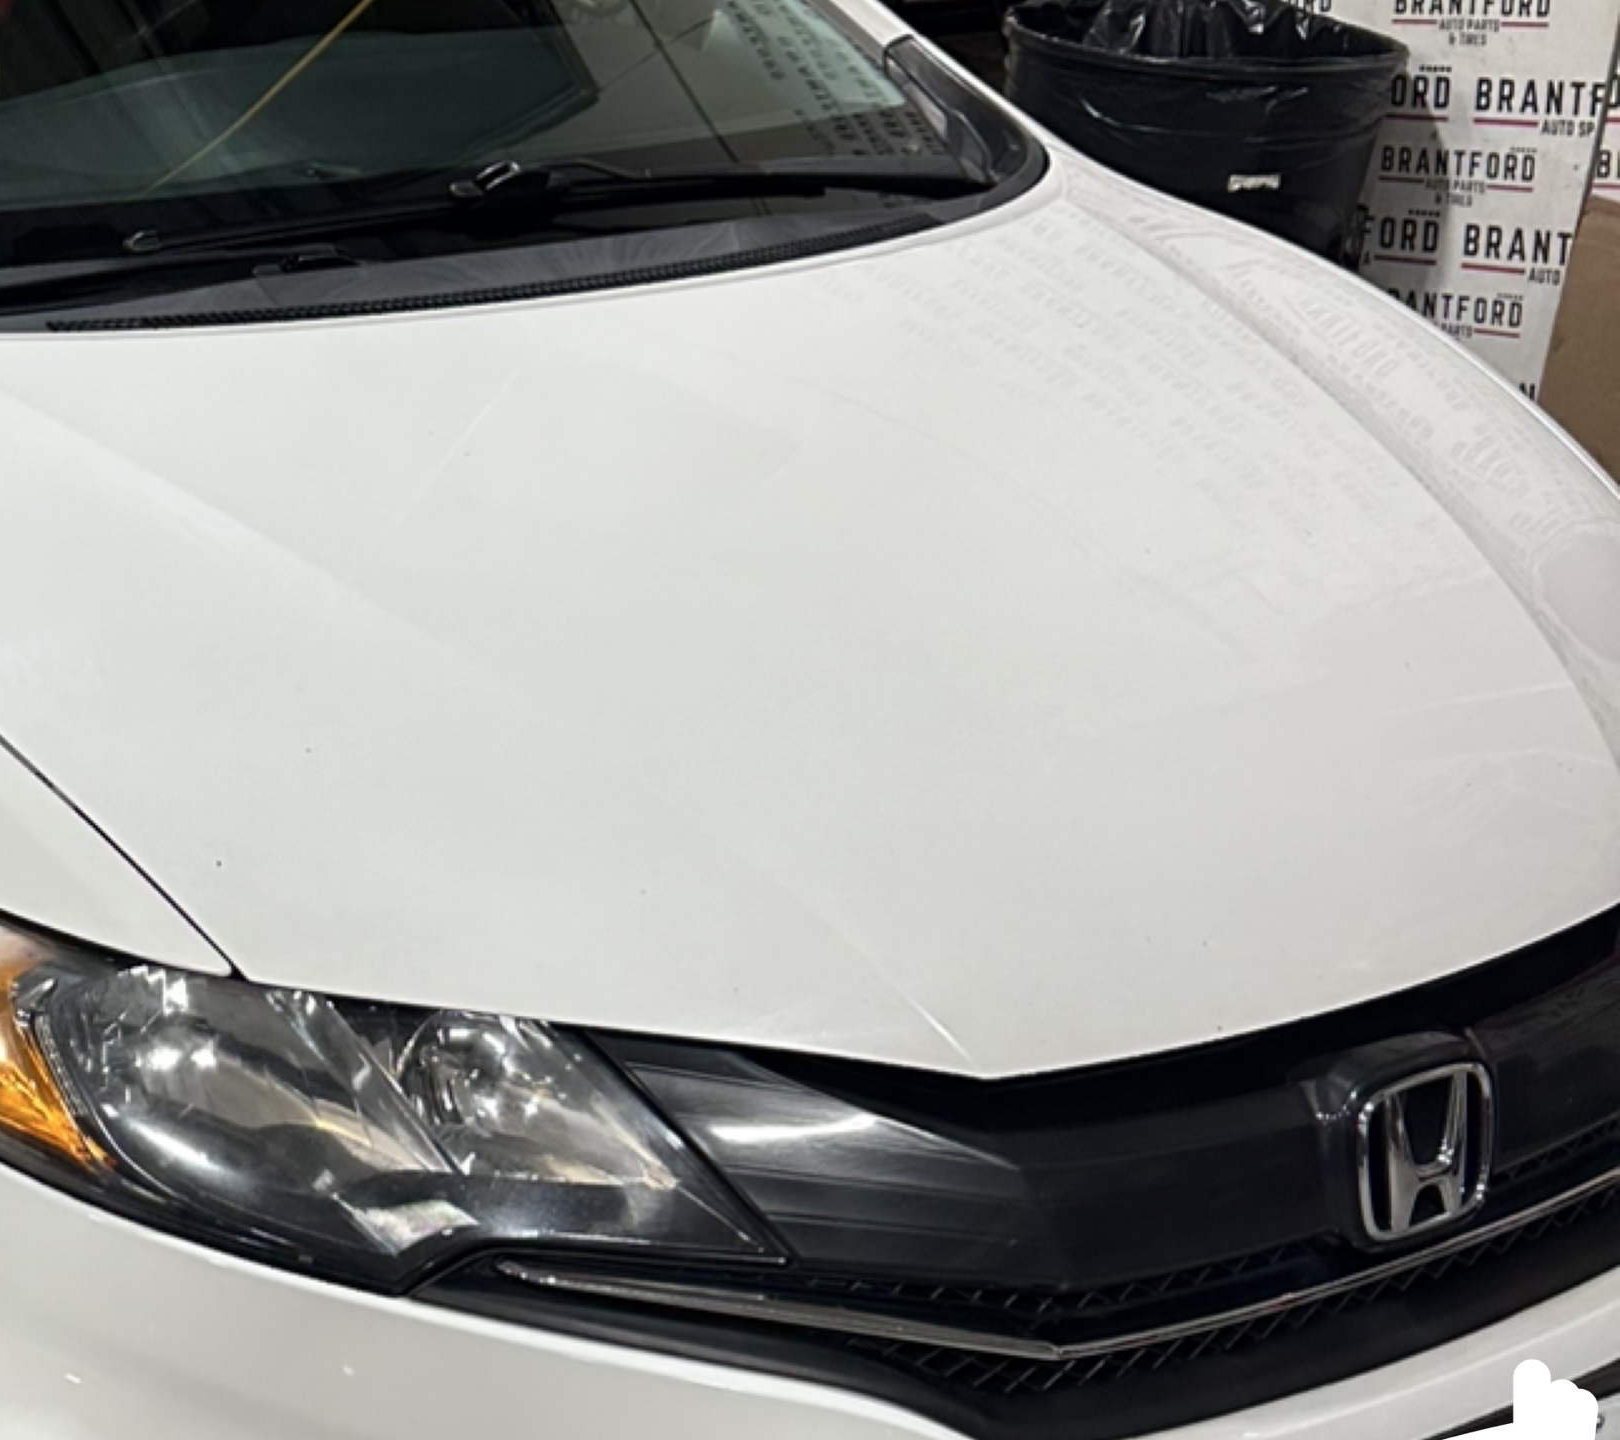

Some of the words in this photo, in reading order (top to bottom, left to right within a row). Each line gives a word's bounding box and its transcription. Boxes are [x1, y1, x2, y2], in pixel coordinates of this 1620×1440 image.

[1438, 19, 1465, 32] AUTO
[1468, 19, 1499, 32] PARTS
[1541, 121, 1573, 135] AUTO
[1577, 122, 1595, 136] SP
[1382, 147, 1535, 181] BRANTFORD
[1464, 224, 1572, 265] BRANT
[1528, 269, 1560, 285] AUTO
